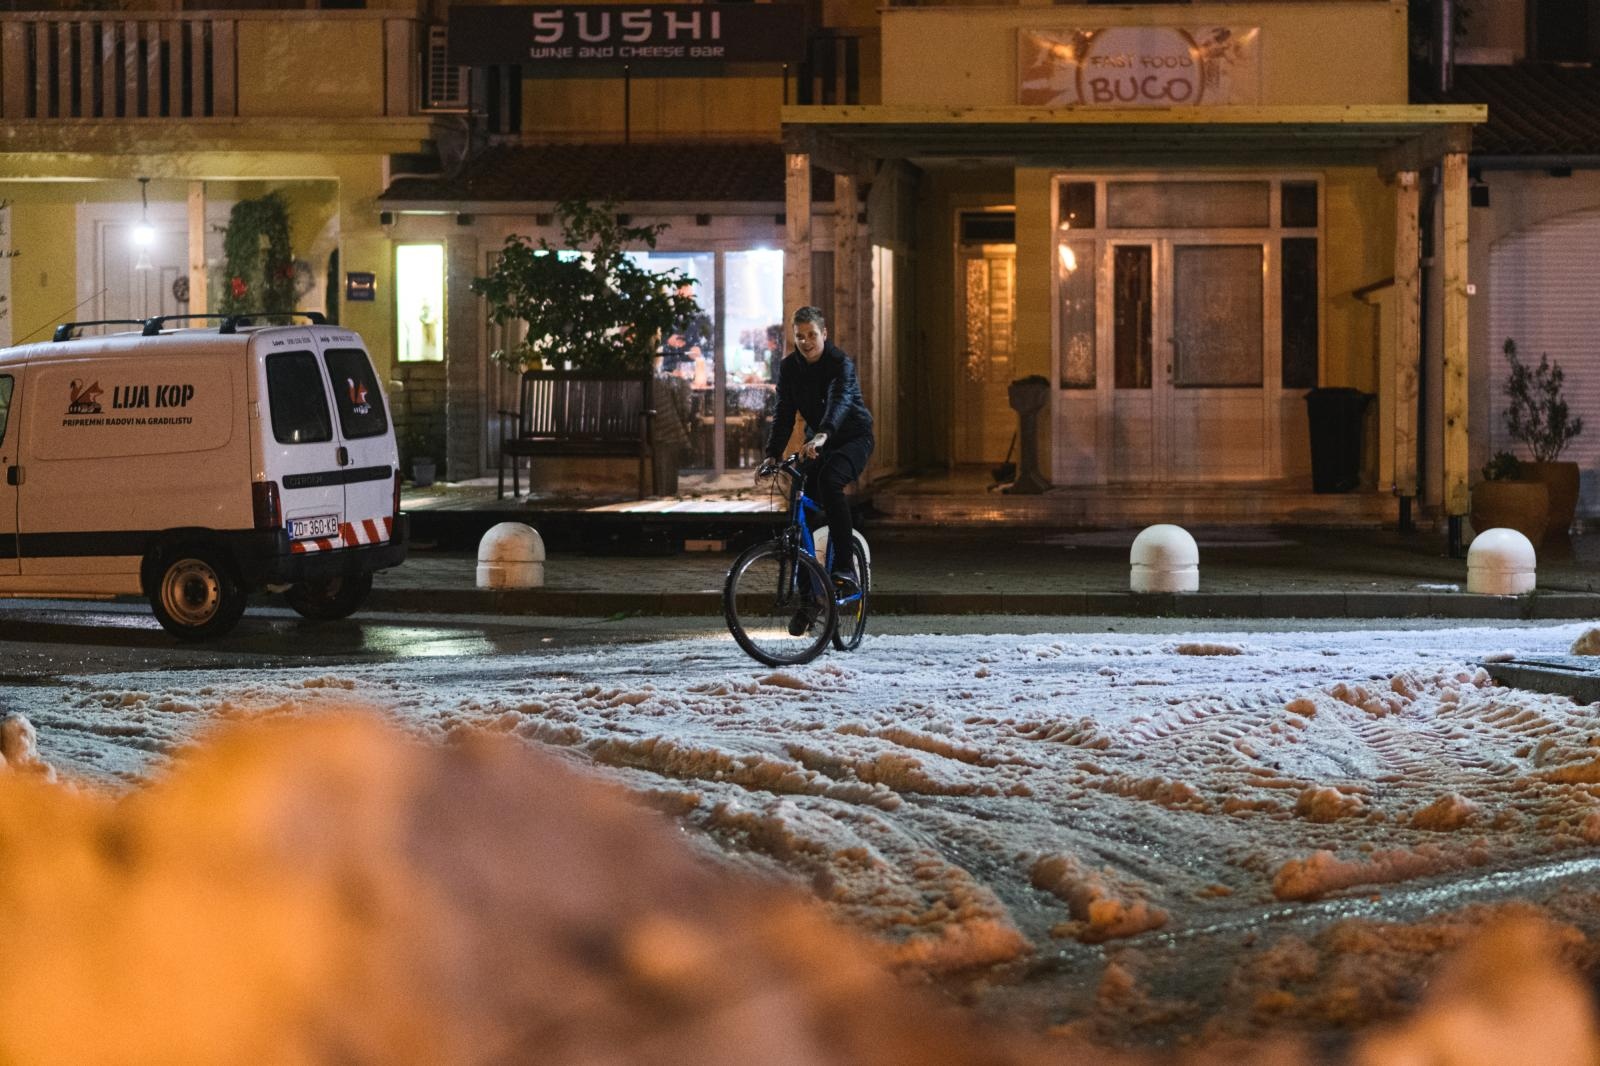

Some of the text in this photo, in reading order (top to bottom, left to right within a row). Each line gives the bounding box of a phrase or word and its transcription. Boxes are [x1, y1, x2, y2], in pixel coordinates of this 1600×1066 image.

[532, 9, 721, 43] SUSHI
[530, 46, 573, 58] WINE
[619, 46, 685, 57] CHEESE
[1090, 54, 1194, 69] FAST FOOD
[112, 384, 195, 409] LIJA KOP
[62, 417, 105, 427] PRIPREMNI
[105, 417, 134, 426] RADOVI
[135, 416, 146, 426] NA
